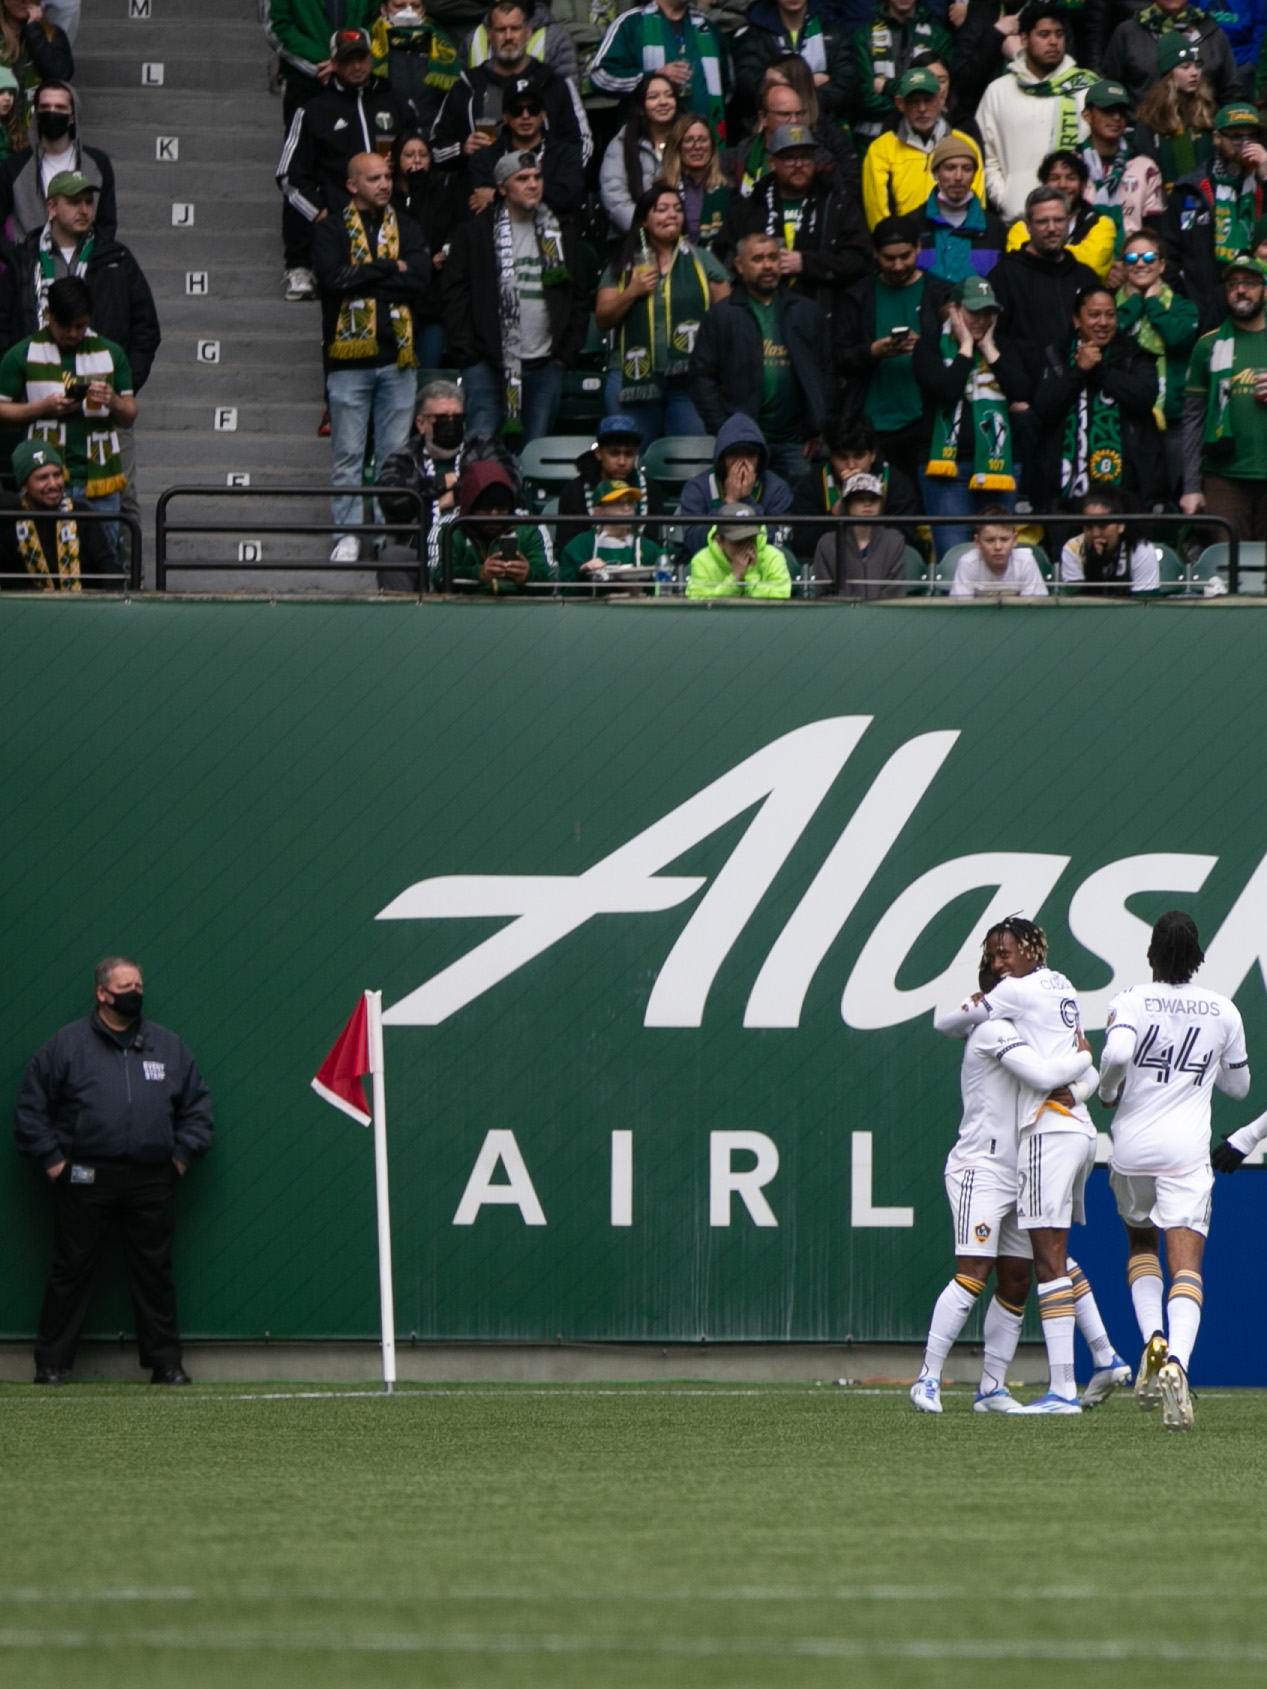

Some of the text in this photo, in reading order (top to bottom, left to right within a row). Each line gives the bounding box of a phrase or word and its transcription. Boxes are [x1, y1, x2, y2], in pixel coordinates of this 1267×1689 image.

[131, 0, 149, 17] M
[146, 65, 159, 83] L
[160, 139, 175, 158] K
[178, 205, 189, 224] J
[189, 275, 205, 293] H
[200, 342, 216, 361] G
[219, 410, 232, 429] F
[243, 543, 258, 562] D
[1144, 998, 1221, 1016] EDWARDS
[1133, 1024, 1213, 1086] 44
